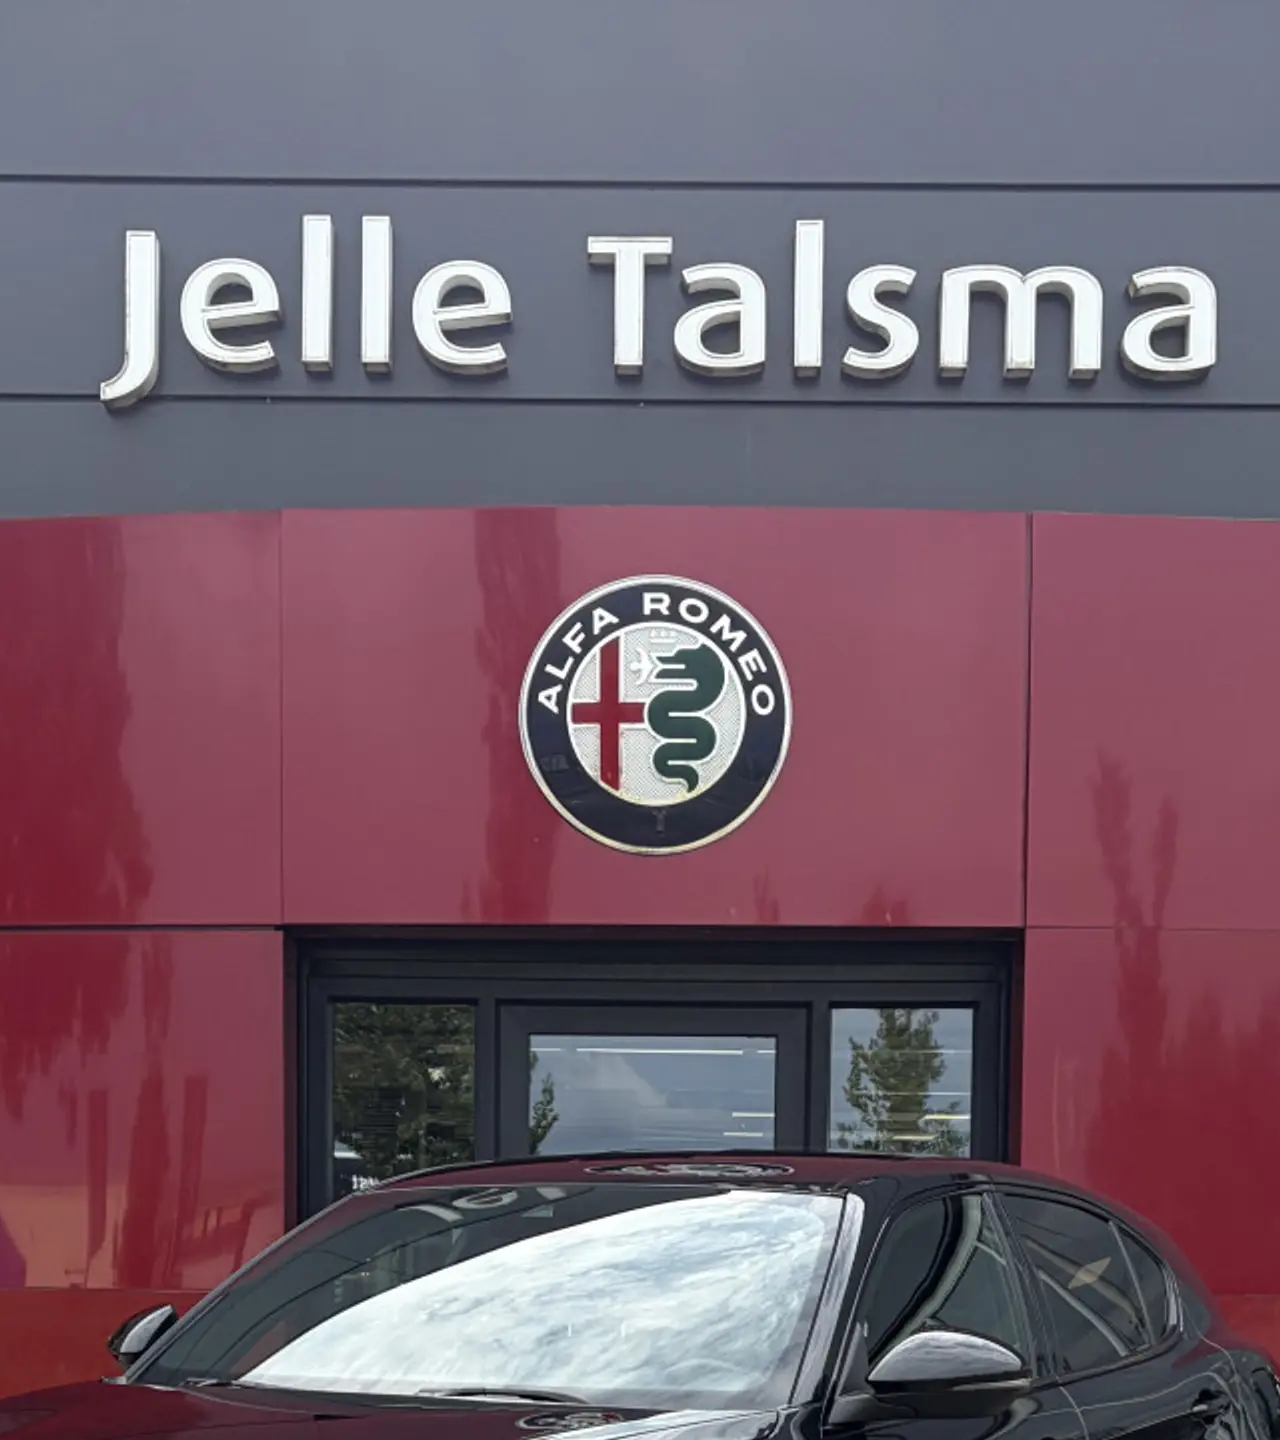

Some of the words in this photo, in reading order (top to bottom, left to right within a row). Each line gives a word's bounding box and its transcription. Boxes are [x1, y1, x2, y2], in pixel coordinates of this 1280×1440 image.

[100, 214, 512, 403] Jelle
[587, 219, 1218, 380] Talsma
[538, 606, 620, 714] ALFA
[642, 591, 776, 716] ROMEO
